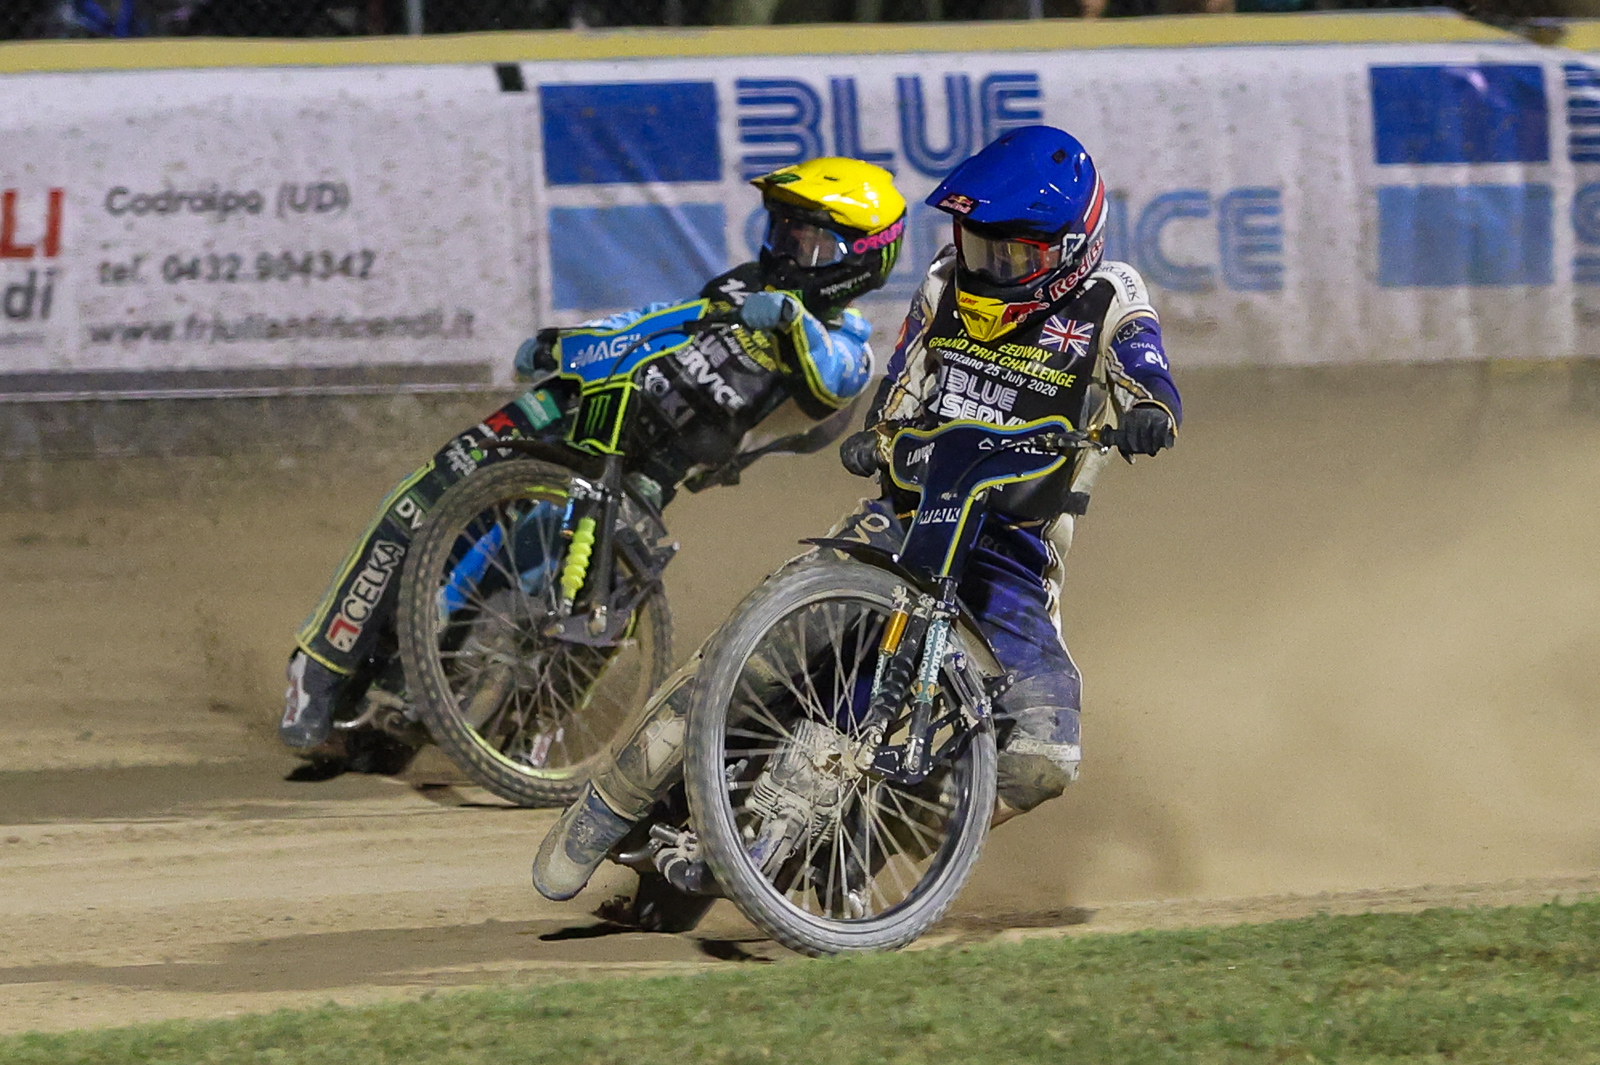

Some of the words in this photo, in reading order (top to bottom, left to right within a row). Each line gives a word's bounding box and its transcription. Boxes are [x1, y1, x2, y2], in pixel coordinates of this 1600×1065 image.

[735, 69, 1045, 179] BLUE
[4, 267, 62, 320] di
[1049, 256, 1090, 301] Red
[929, 337, 969, 351] GRAND
[967, 343, 1000, 362] PRIX
[999, 356, 1077, 388] CHALLENGE
[998, 343, 1052, 362] EEDWAY
[945, 367, 1018, 412] BLUE
[984, 363, 1001, 377] 25
[1001, 370, 1026, 388] July
[1027, 378, 1058, 397] 2026
[344, 543, 403, 622] CELKA
[928, 625, 949, 685] MOTOREX
